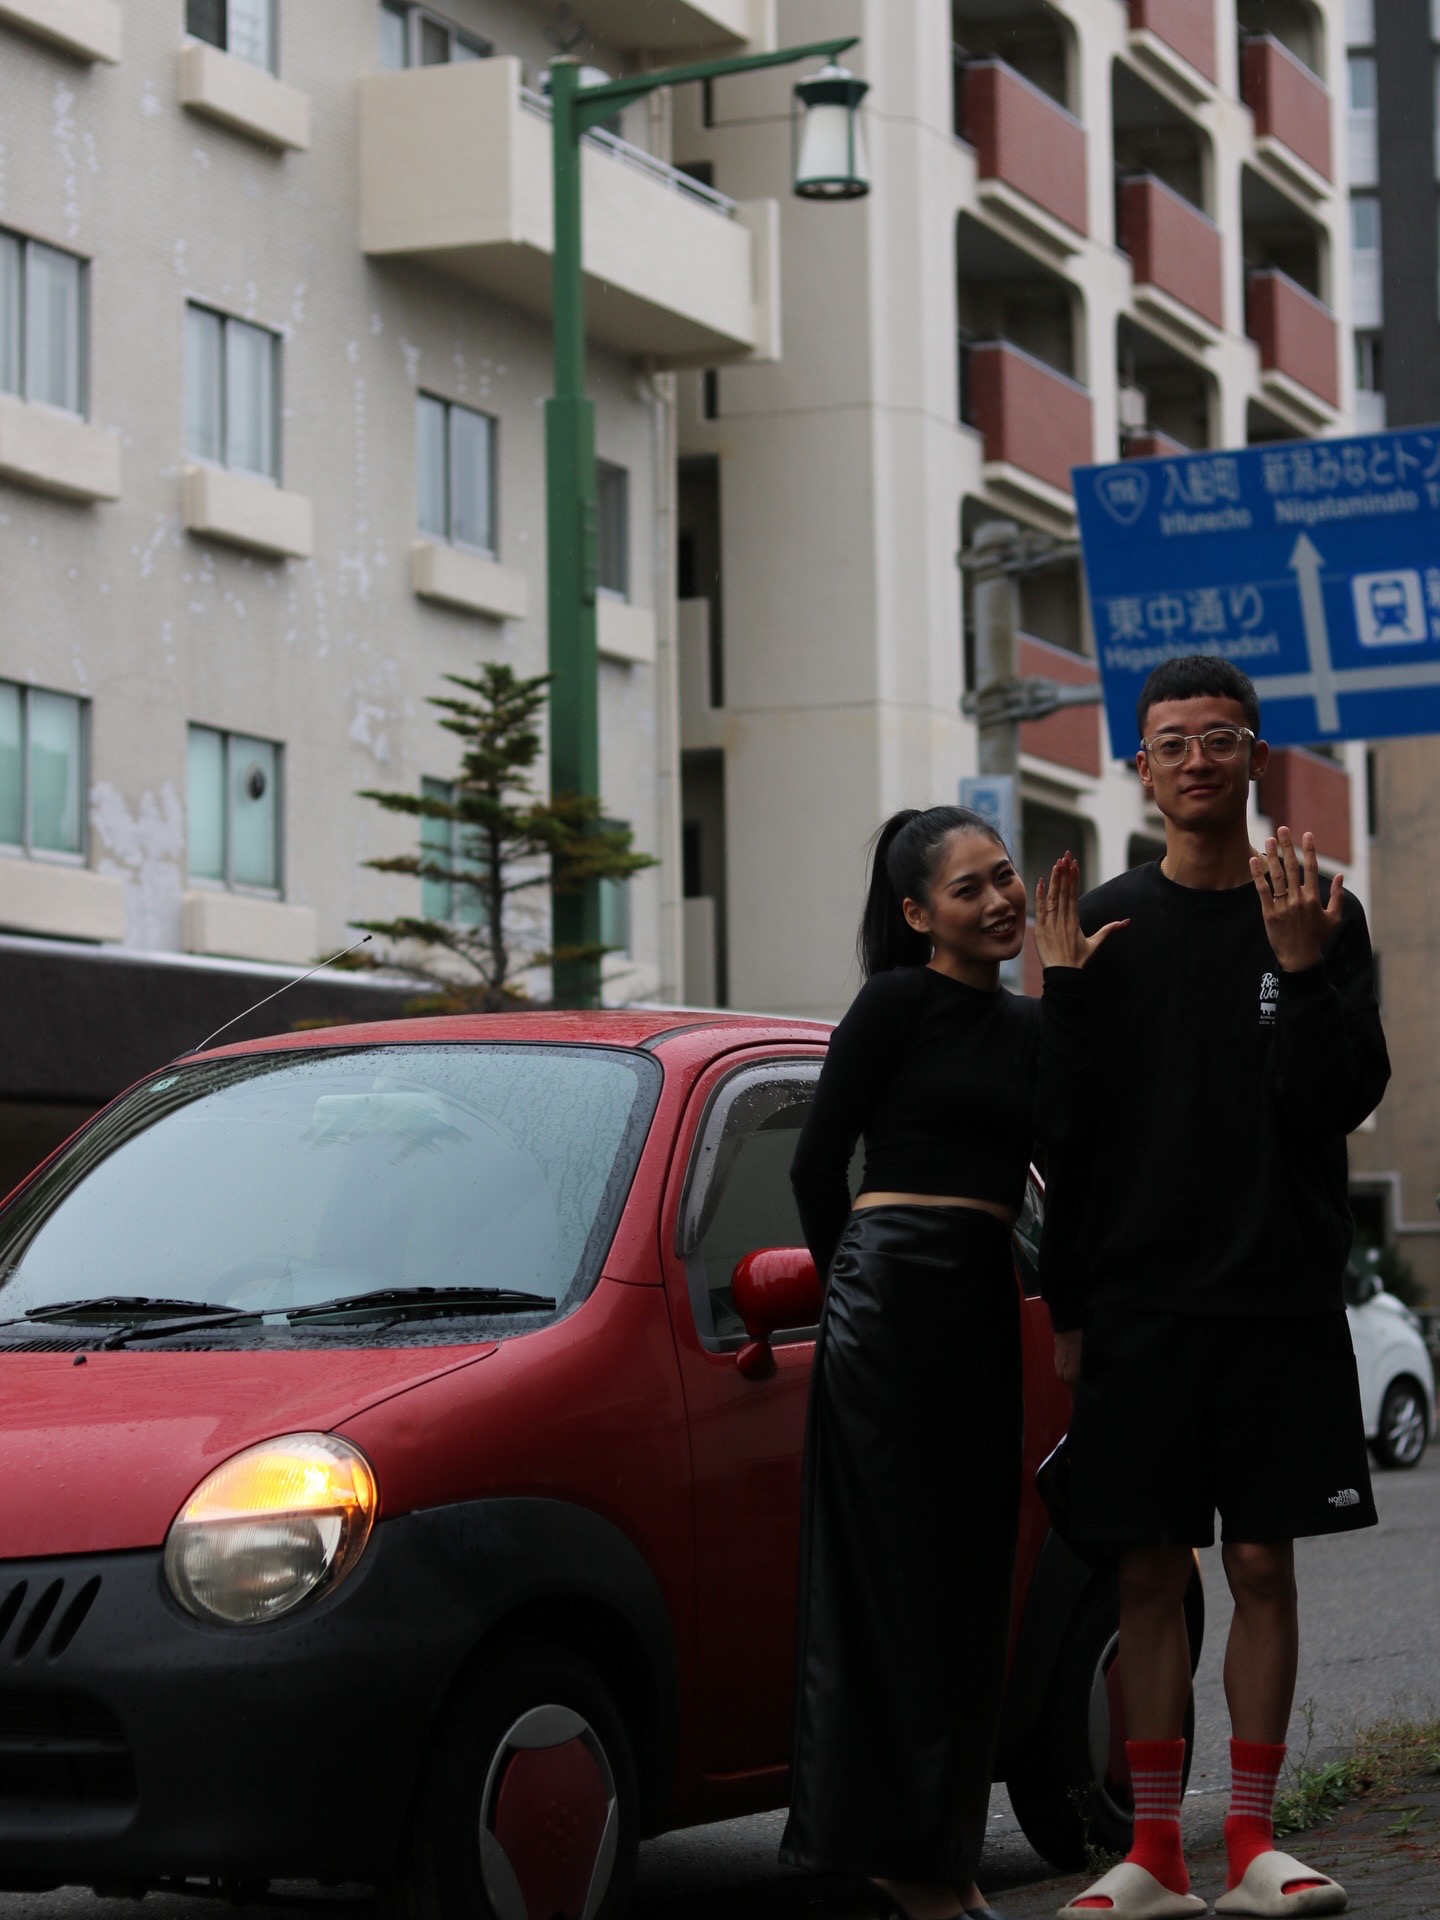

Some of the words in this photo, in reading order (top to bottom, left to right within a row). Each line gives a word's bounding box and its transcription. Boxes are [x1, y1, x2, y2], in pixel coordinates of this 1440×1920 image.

[1105, 586, 1264, 641] 東中通り
[1328, 1496, 1350, 1504] NORTH
